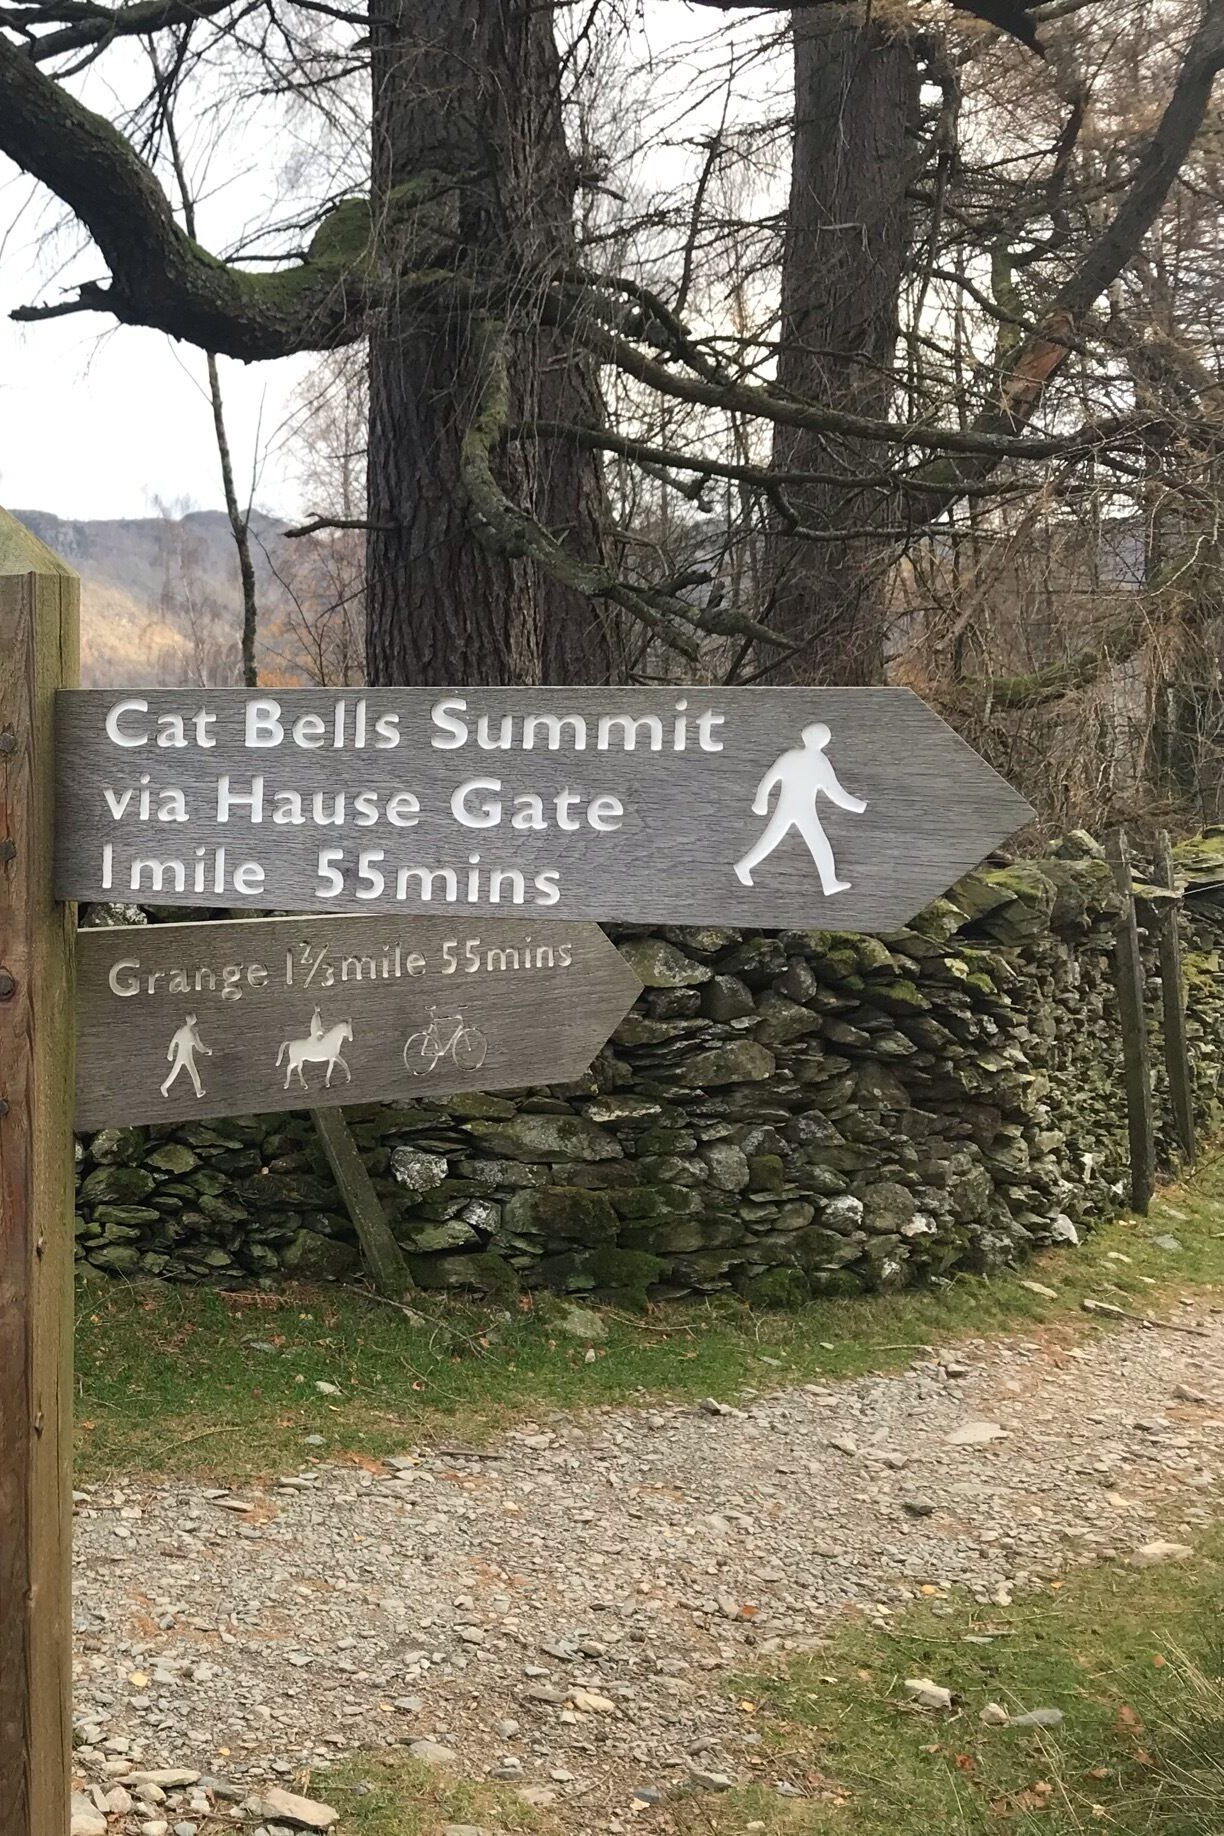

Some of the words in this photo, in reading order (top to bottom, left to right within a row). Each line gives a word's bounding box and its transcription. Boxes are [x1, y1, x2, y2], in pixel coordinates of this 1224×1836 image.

[105, 699, 217, 748] Cat
[243, 698, 401, 749] Bells
[431, 697, 725, 752] Summit
[103, 774, 190, 822] via
[216, 775, 421, 827] Hause
[450, 778, 624, 832] Gate
[314, 849, 561, 906] 55mins
[108, 957, 268, 1002] Grange
[441, 936, 573, 975] 55mins
